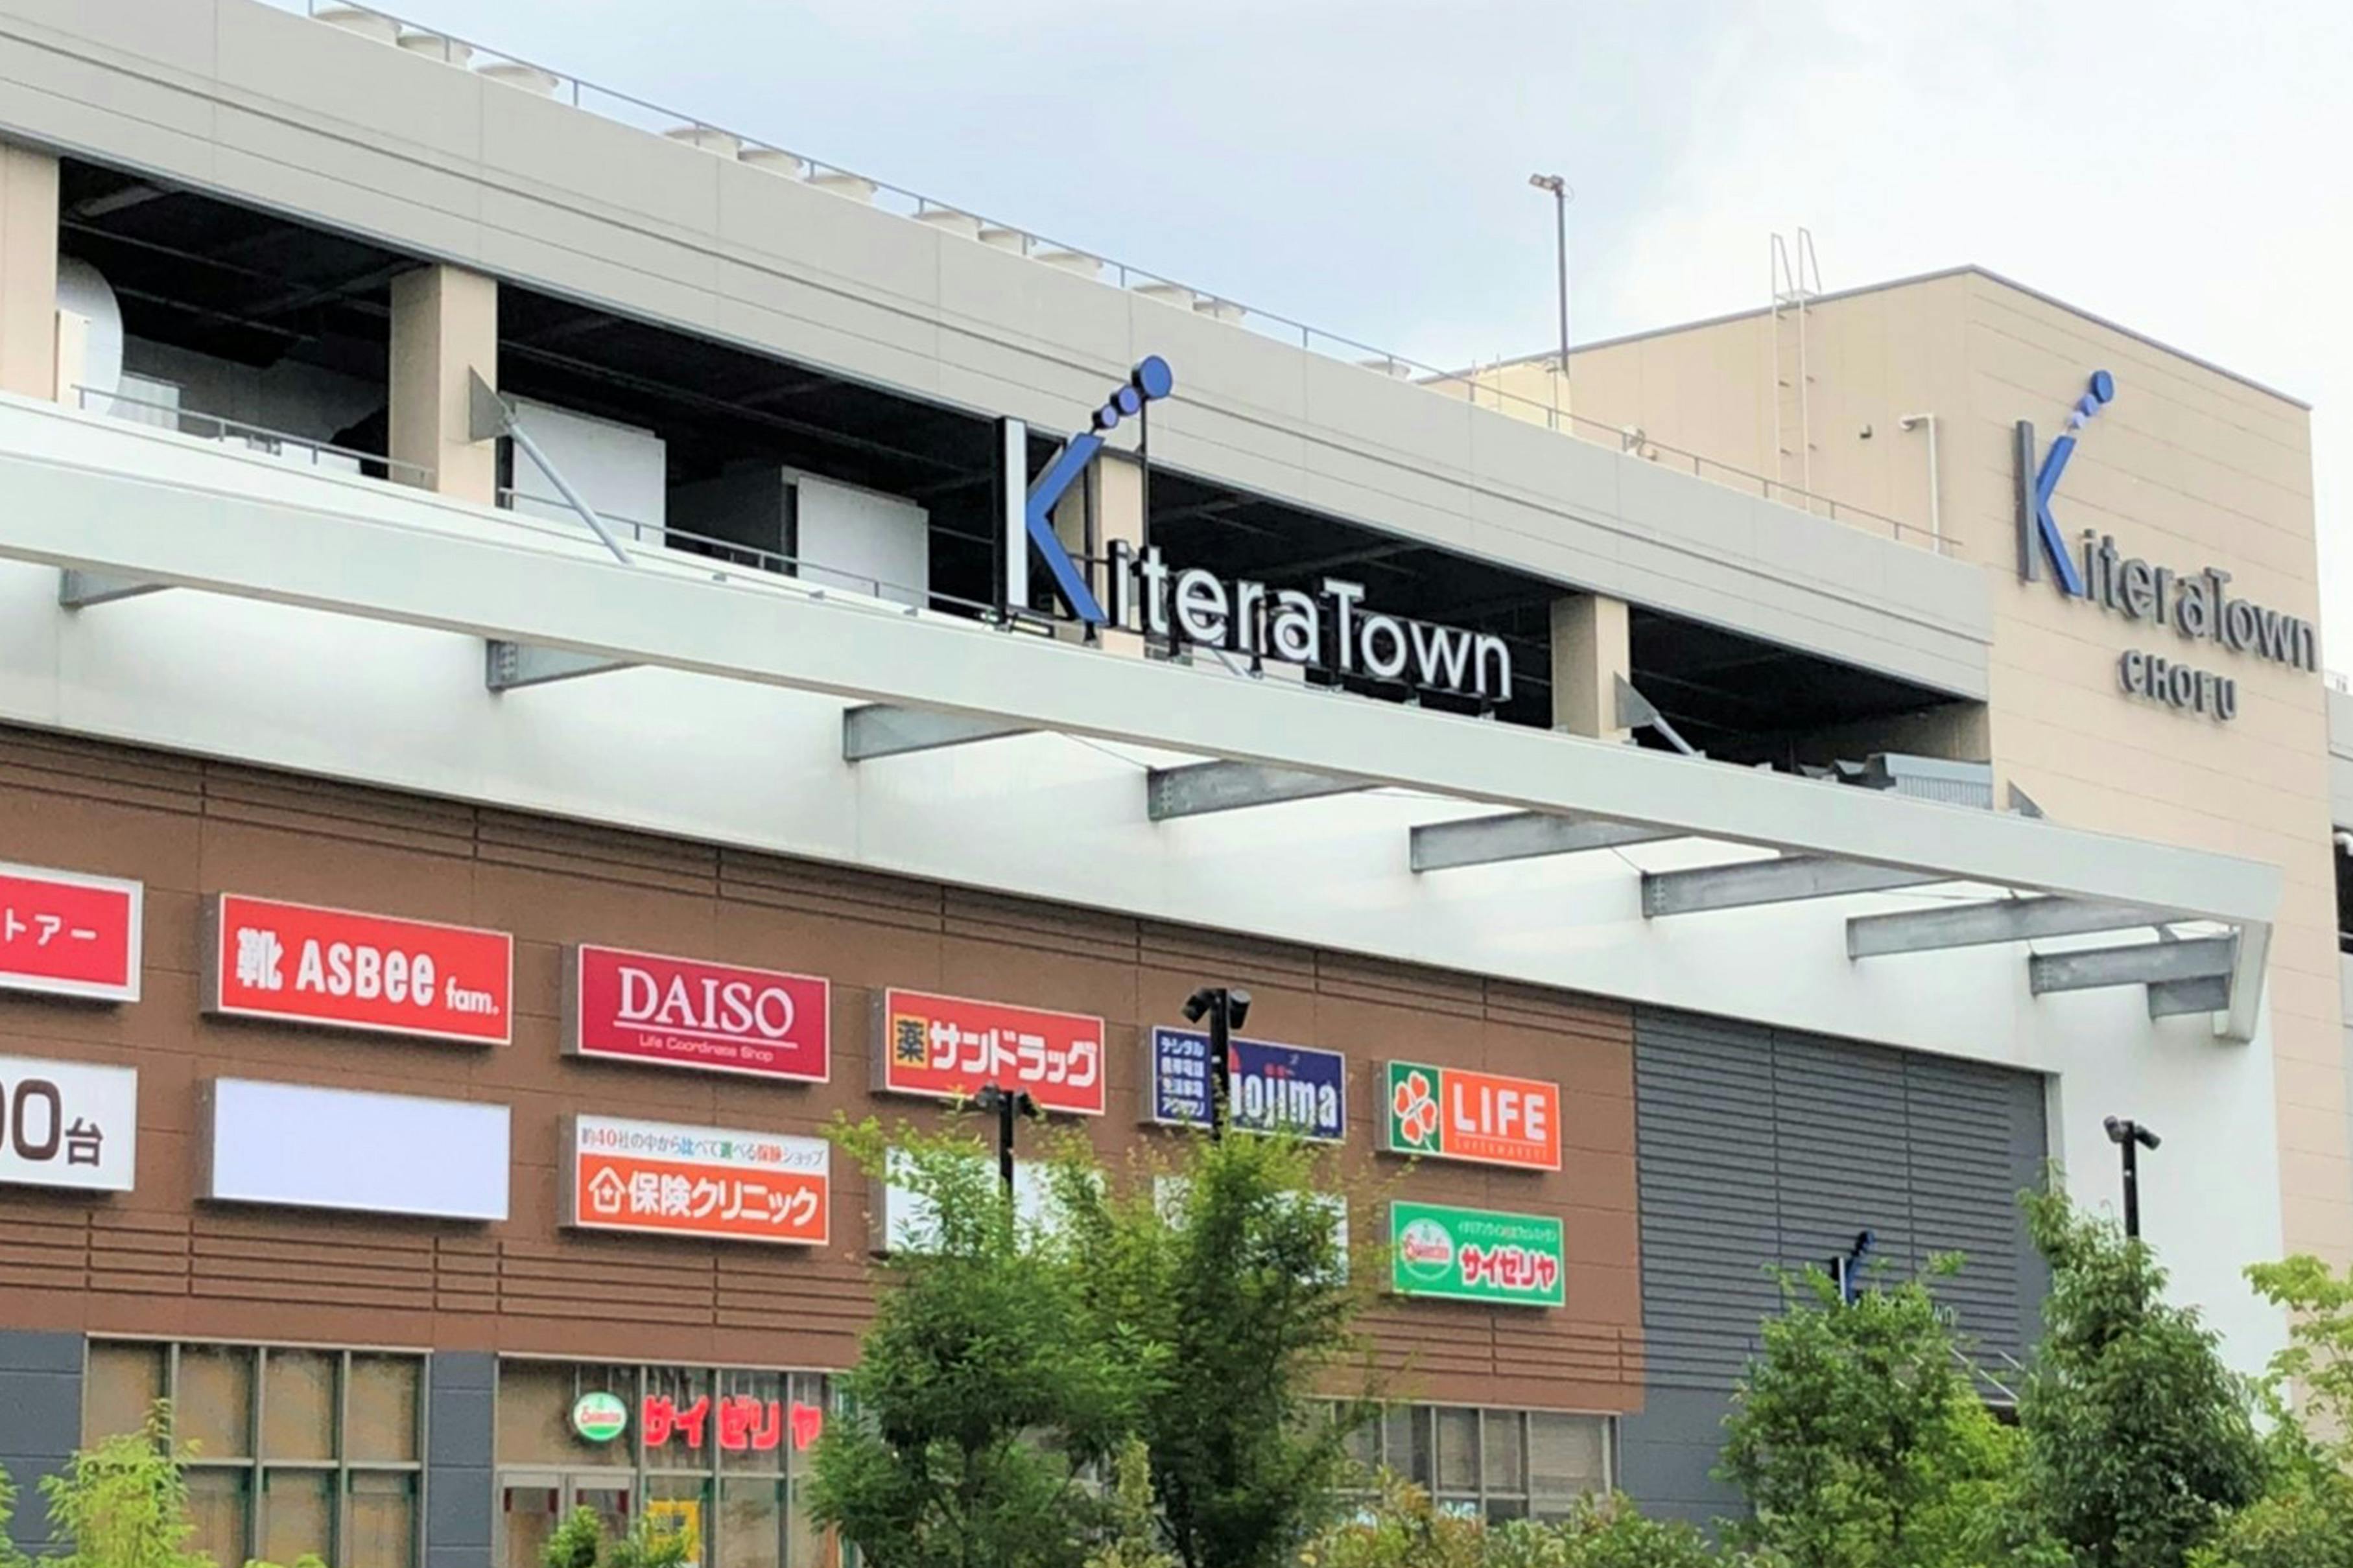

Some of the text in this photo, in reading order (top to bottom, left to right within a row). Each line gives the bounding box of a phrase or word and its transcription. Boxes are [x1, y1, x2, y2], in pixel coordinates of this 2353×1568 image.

[1002, 355, 1513, 701] KiteraTown
[2016, 369, 2318, 673] KiteraTown
[2119, 649, 2237, 720] CHOFU
[237, 927, 500, 1016] 靴 ASBee fam.
[618, 966, 795, 1038] DAISO
[929, 1020, 1098, 1088] サンドラッグ
[0, 1077, 104, 1167] 0台
[1453, 1082, 1547, 1141] LIFE
[628, 1169, 819, 1226] 保険クリニック
[1459, 1243, 1557, 1293] サイゼリヤ
[642, 1394, 822, 1451] サイゼリヤ
